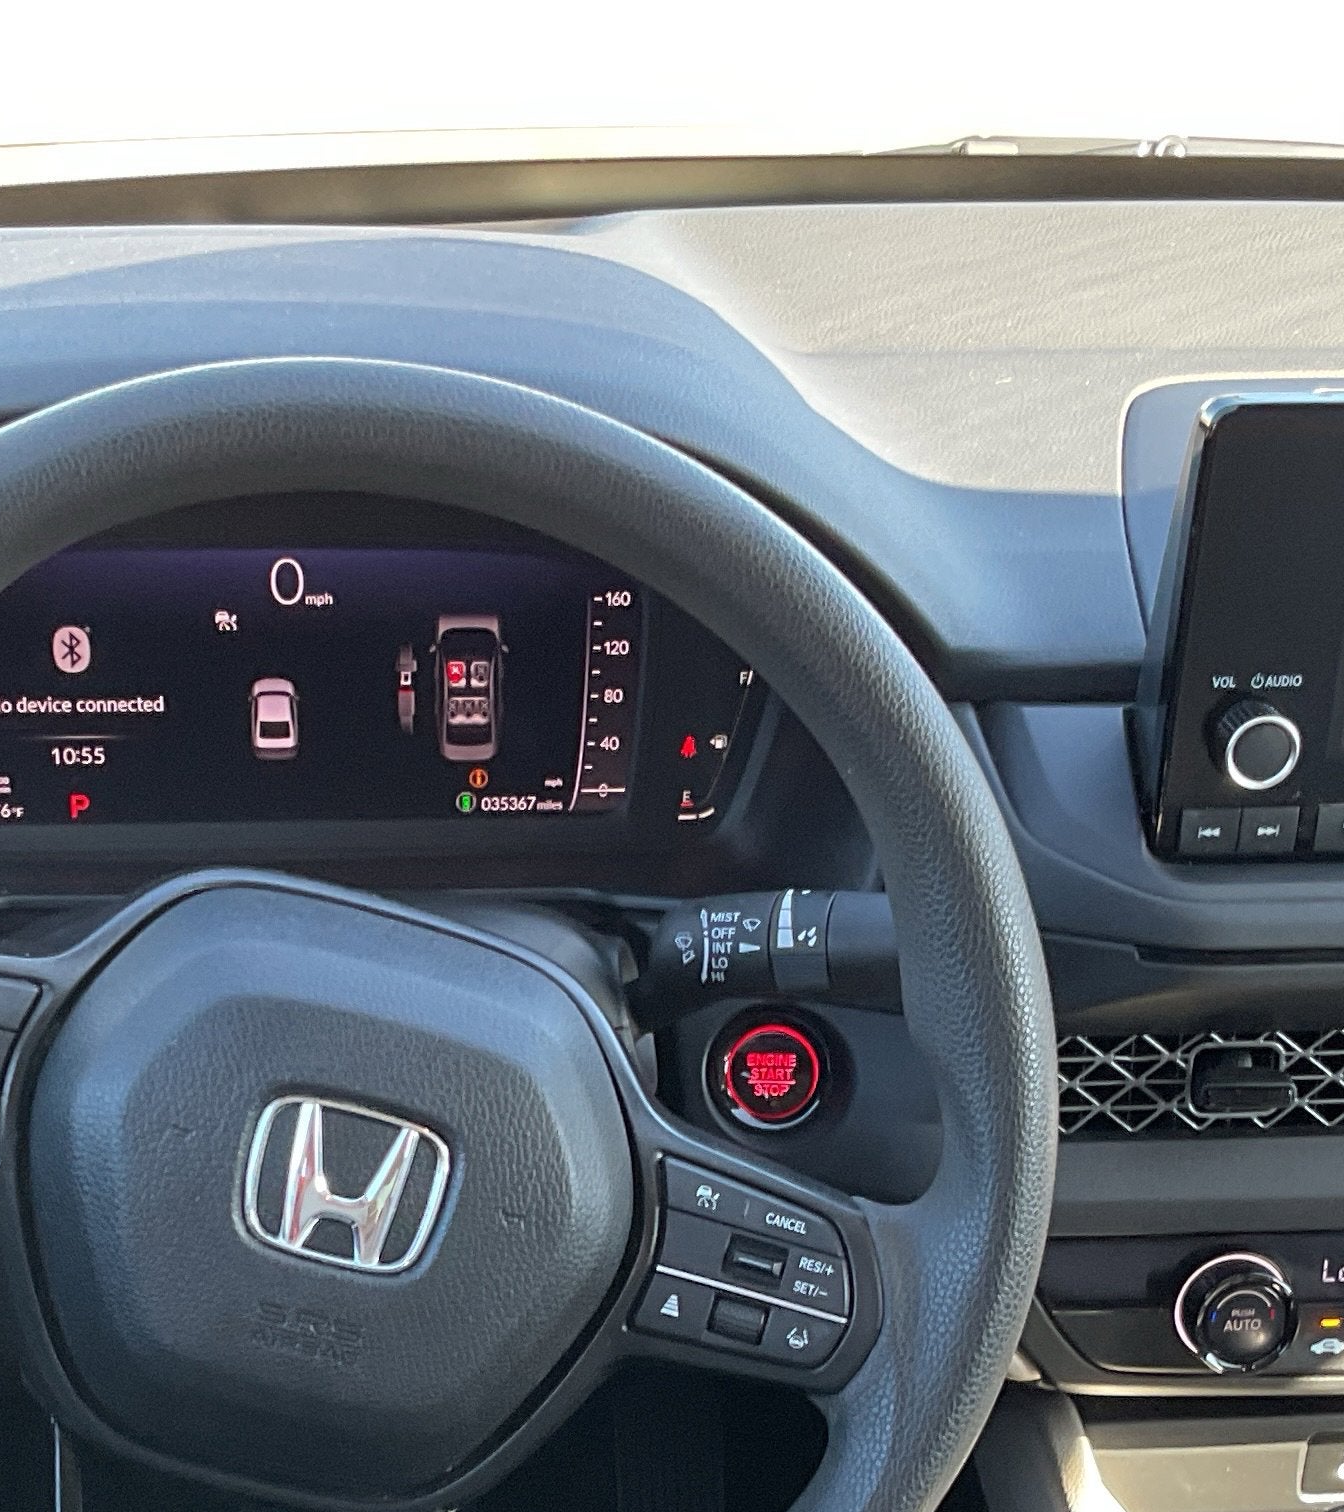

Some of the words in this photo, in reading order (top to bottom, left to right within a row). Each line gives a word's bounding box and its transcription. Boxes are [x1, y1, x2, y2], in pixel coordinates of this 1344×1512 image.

[270, 558, 304, 605] 0
[304, 592, 334, 607] mph
[605, 591, 632, 607] 160
[603, 640, 630, 655] 120
[1212, 675, 1236, 689] VOL
[1264, 674, 1302, 688] AUDIO
[603, 688, 623, 703] 80
[16, 696, 72, 713] device
[76, 695, 165, 713] connected
[599, 736, 620, 750] 40
[51, 747, 106, 765] 10:55
[480, 795, 537, 811] 035367
[682, 789, 692, 804] E
[69, 793, 91, 819] P
[711, 911, 741, 923] MIST
[711, 928, 736, 939] OFF
[711, 942, 733, 954] INT
[711, 957, 729, 969] LO
[746, 1053, 798, 1067] ENGINE
[750, 1067, 793, 1081] START
[754, 1084, 790, 1097] STOP
[765, 1212, 808, 1235] CANCEL
[1223, 1319, 1262, 1332] AUTO
